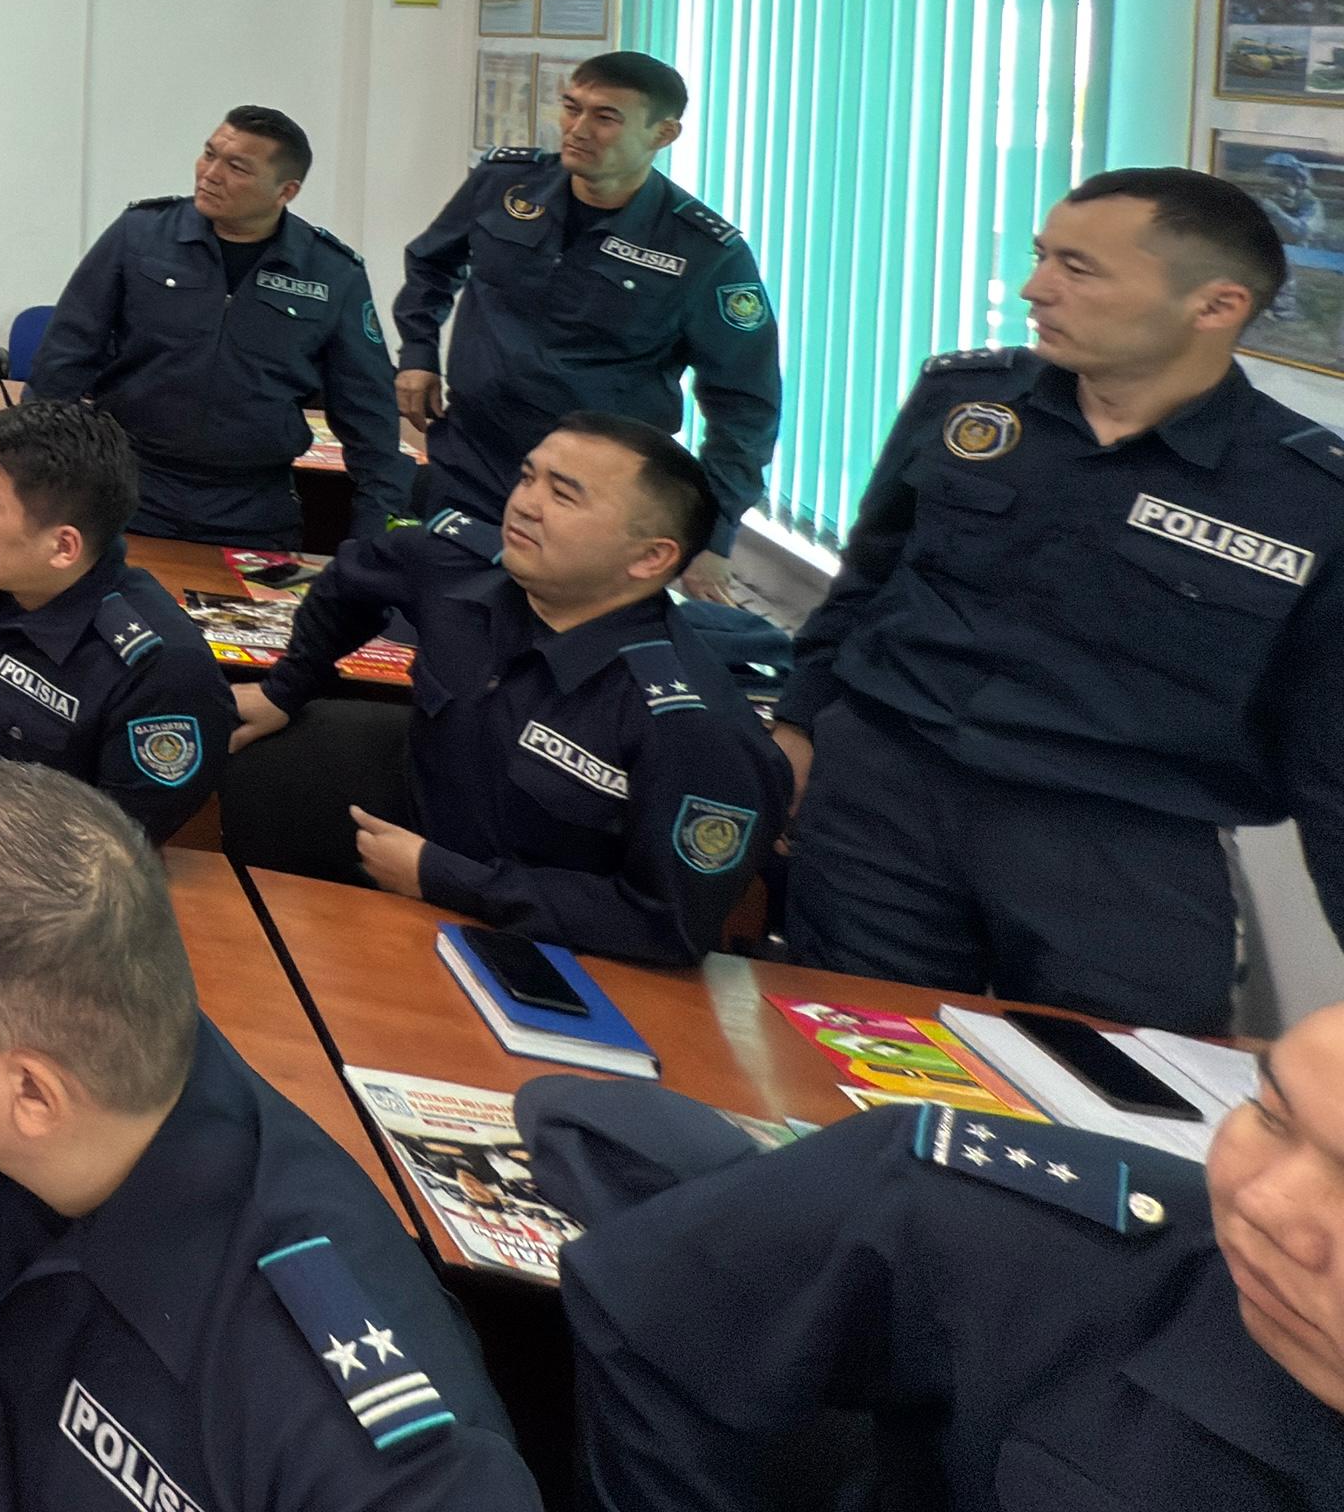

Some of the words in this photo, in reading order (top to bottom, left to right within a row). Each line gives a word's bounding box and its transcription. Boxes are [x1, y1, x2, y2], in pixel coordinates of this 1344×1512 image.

[607, 240, 679, 271] POLISIA
[259, 274, 325, 296] POLISIA
[1143, 503, 1297, 575] POLISIA
[3, 662, 69, 715] POLISIA
[528, 730, 627, 793] POLISIA
[72, 1395, 197, 1512] POLIS
